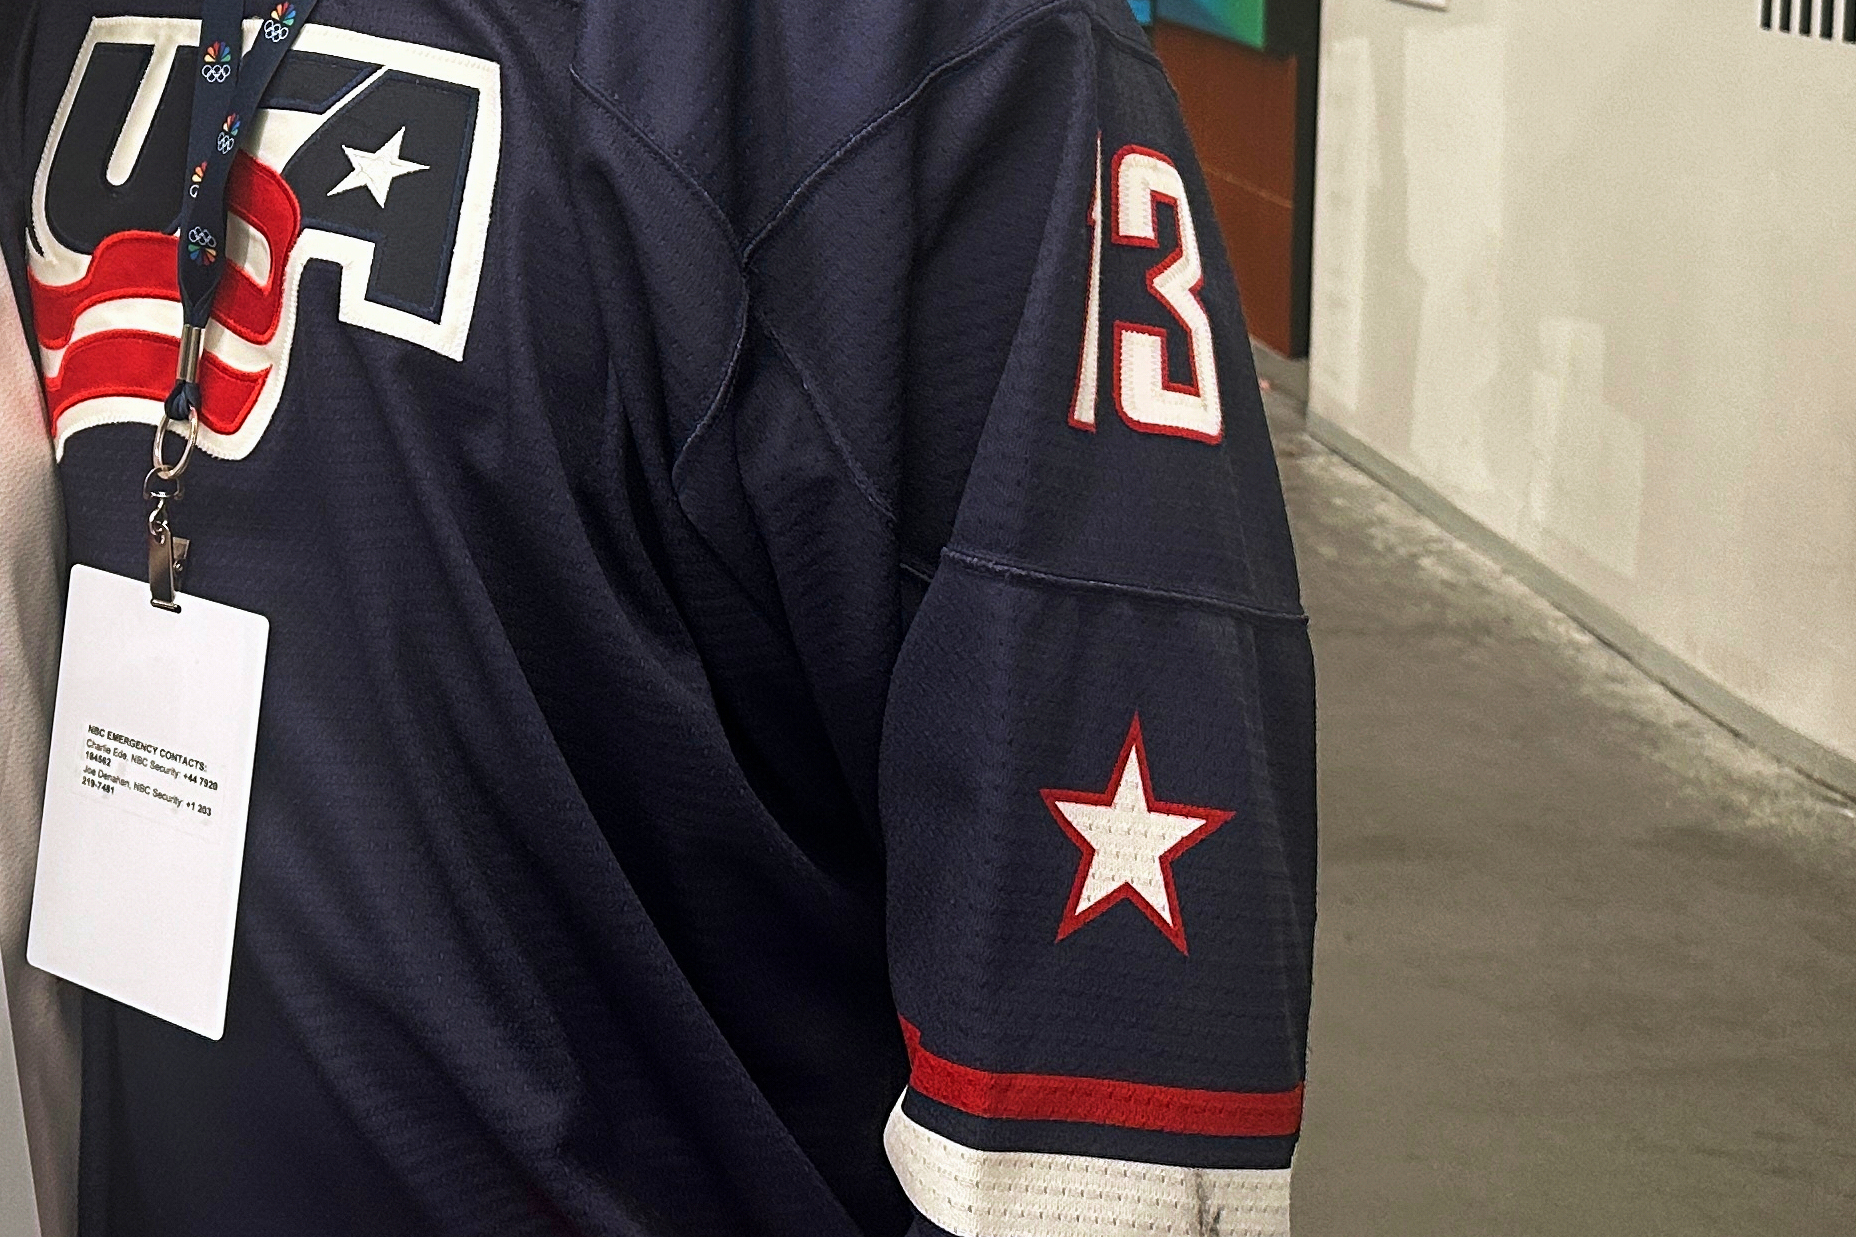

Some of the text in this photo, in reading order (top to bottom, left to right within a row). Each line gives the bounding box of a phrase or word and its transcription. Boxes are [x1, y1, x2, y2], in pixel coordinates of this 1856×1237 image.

[88, 724, 207, 773] NBC EMERGENCY CONTACTS:
[83, 765, 96, 776] Joe
[133, 781, 150, 795] NBC
[131, 754, 148, 768] NBC
[183, 773, 197, 784] +44
